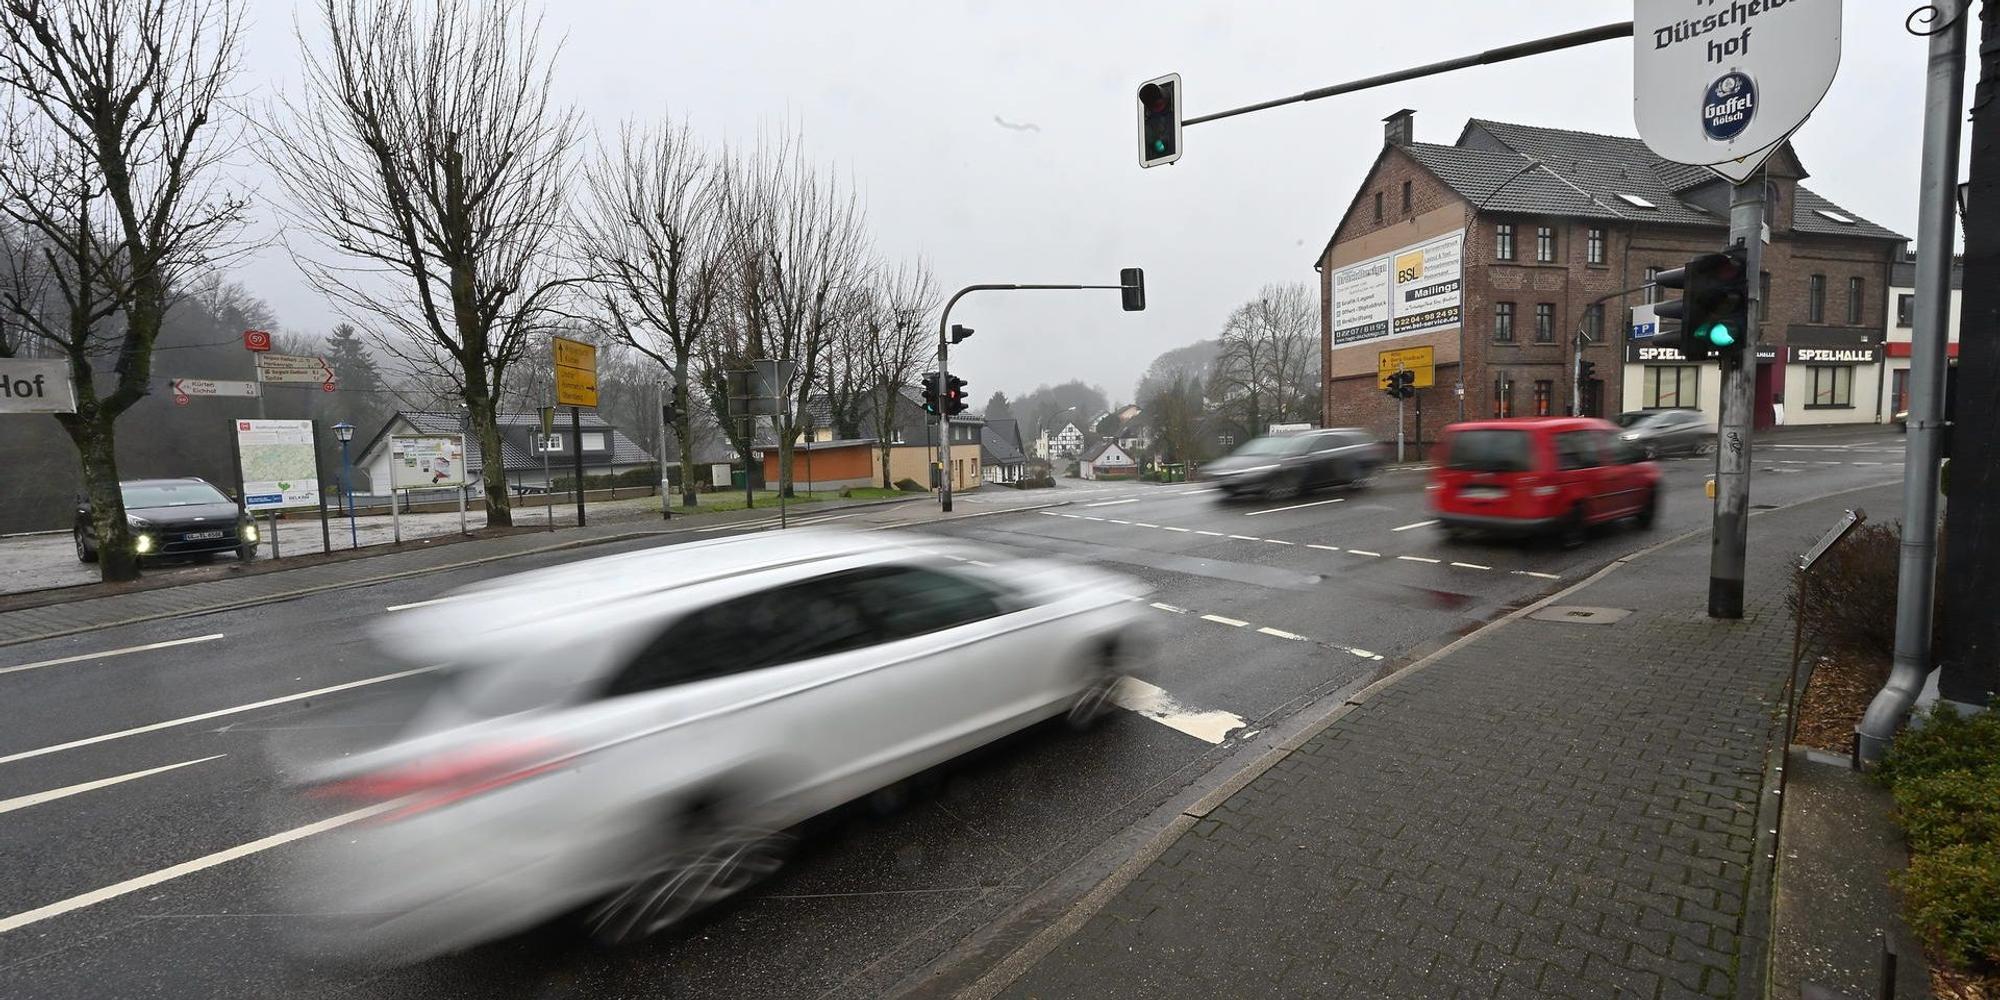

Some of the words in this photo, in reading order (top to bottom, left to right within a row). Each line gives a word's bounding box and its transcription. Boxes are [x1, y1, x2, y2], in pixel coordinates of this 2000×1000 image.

[1653, 0, 1797, 49] Dürschei
[1707, 27, 1752, 64] hof
[1705, 93, 1752, 119] Gaffel
[1713, 111, 1743, 127] Kölsch
[1398, 266, 1419, 284] BSL
[1414, 282, 1458, 299] Mailings
[1642, 325, 1649, 333] P
[1639, 348, 1686, 360] SPIEL
[1798, 349, 1873, 361] SPIELHALLE
